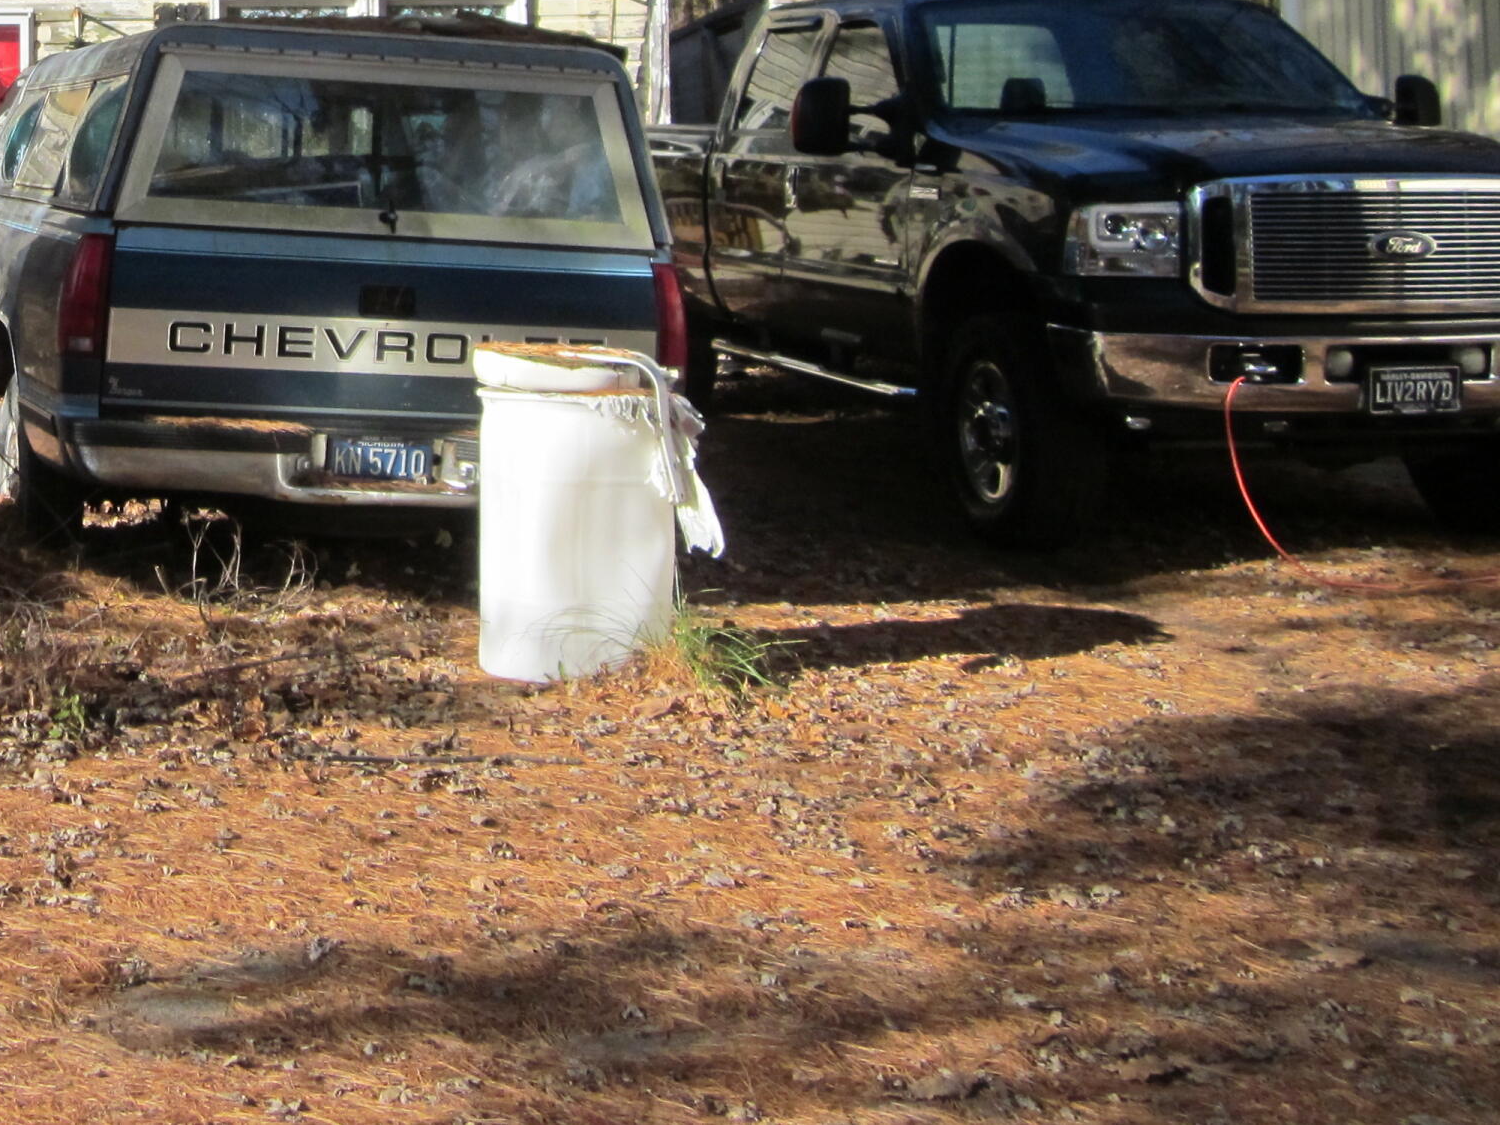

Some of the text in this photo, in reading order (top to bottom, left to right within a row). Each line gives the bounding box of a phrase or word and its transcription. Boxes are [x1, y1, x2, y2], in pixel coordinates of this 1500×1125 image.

[1386, 236, 1422, 253] Ford
[167, 321, 605, 364] CHEVRO
[1376, 380, 1453, 404] LIV2RYD
[334, 447, 425, 477] KN 5710
